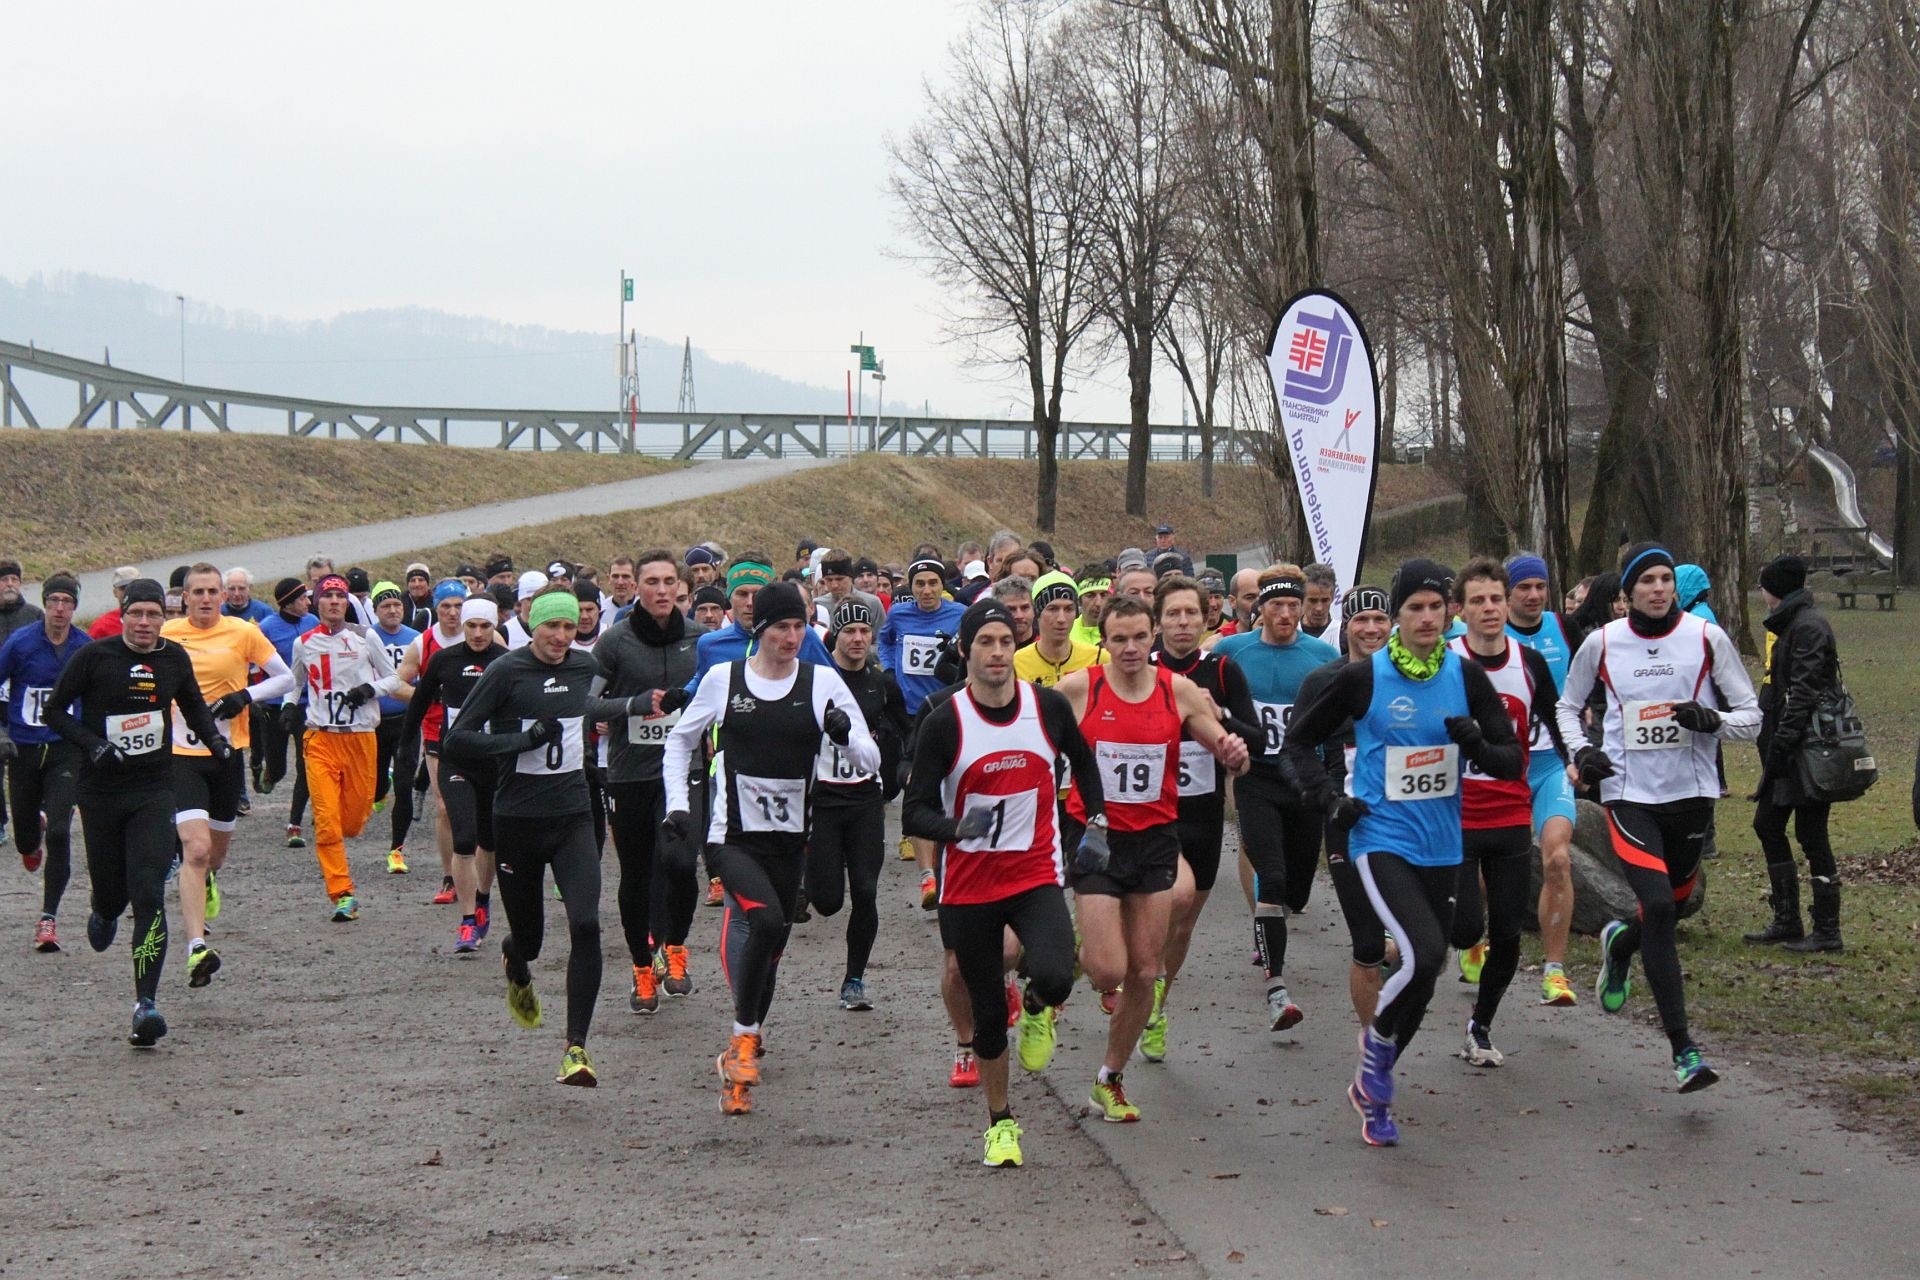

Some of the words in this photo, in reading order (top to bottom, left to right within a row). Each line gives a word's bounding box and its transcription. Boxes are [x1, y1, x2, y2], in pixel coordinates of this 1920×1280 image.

[910, 648, 937, 668] 62
[1633, 667, 1675, 678] GRAVAG
[544, 685, 569, 693] skinfit
[639, 724, 675, 740] 395
[1636, 725, 1680, 745] 382
[119, 733, 156, 751] 356
[983, 758, 1027, 774] GRAVAG
[1410, 749, 1441, 766] rivella
[1113, 763, 1150, 793] 19
[1401, 772, 1447, 795] 365
[756, 795, 790, 823] 13
[989, 798, 1006, 849] 1
